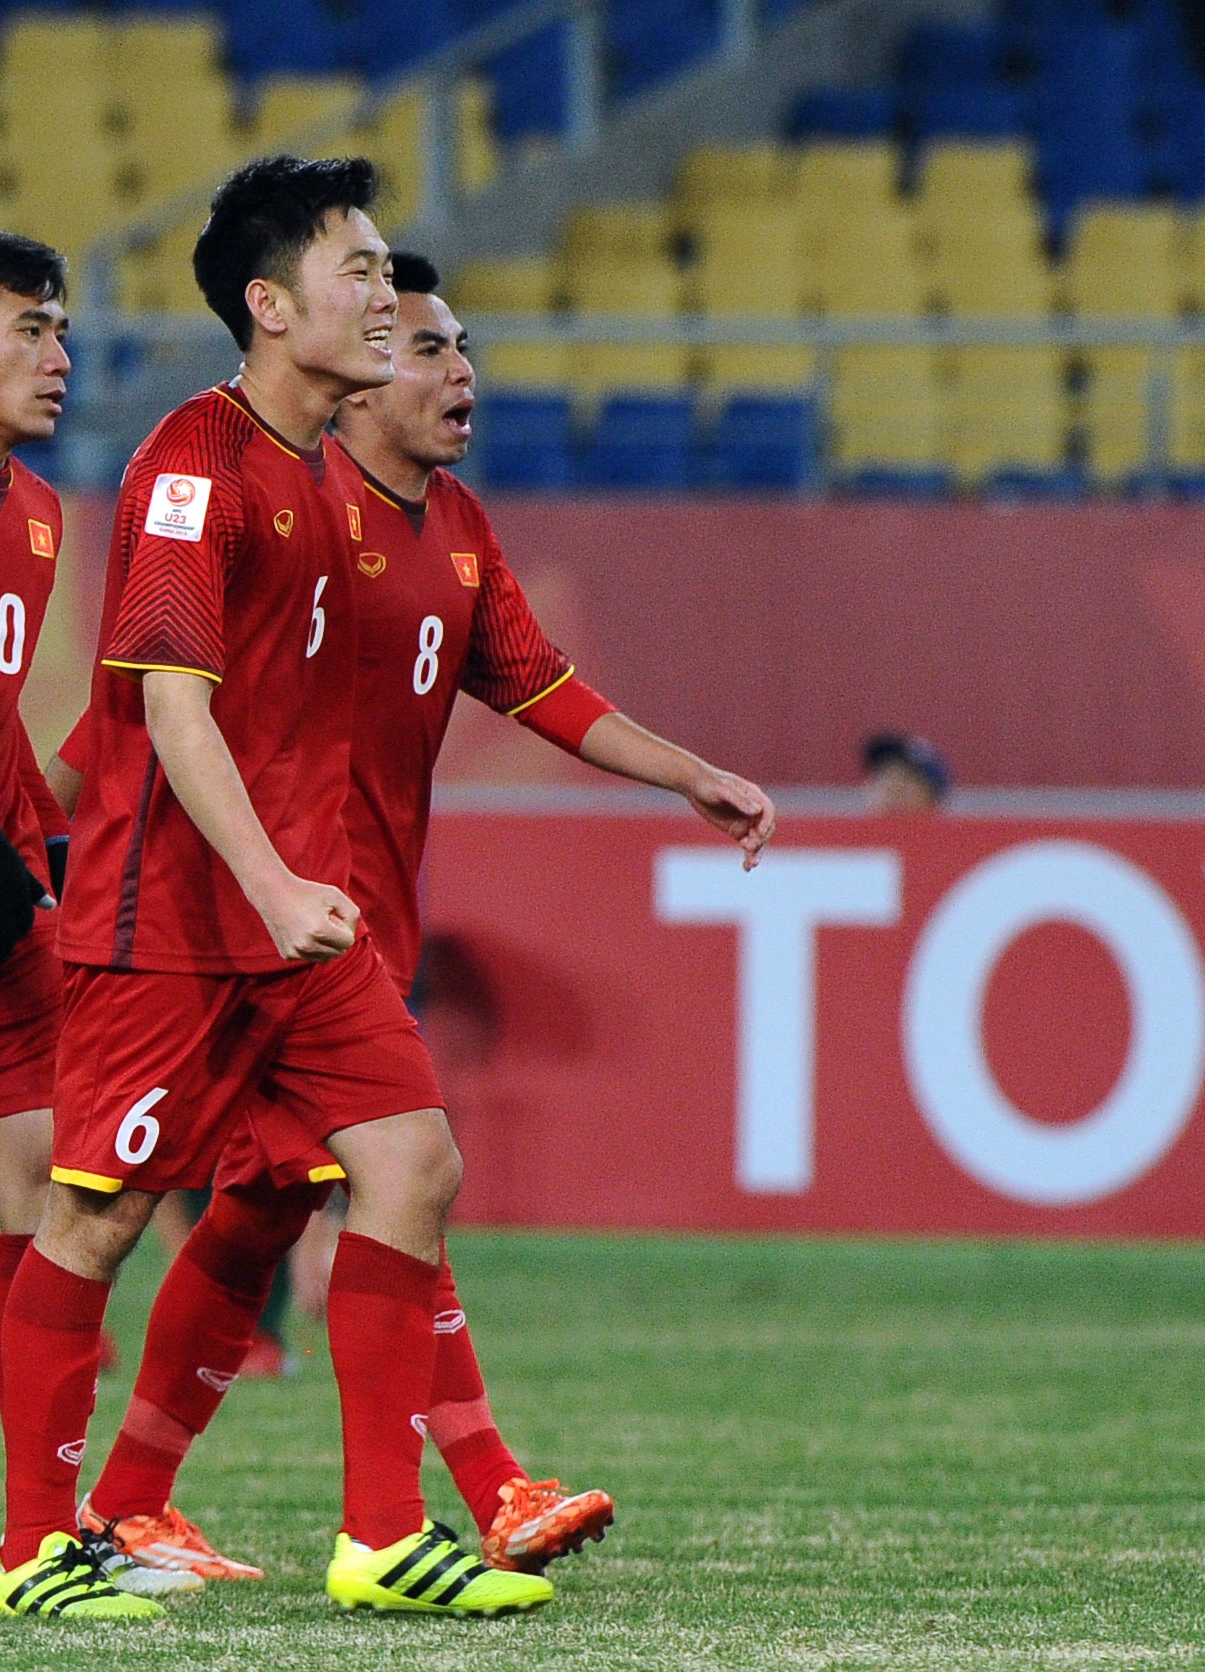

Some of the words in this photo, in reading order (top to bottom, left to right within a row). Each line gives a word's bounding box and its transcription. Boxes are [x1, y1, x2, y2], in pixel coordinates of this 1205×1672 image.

[164, 512, 187, 525] U23
[306, 575, 329, 659] 6
[413, 615, 444, 696] 8
[652, 836, 1205, 1207] TO
[115, 1087, 169, 1165] 6
